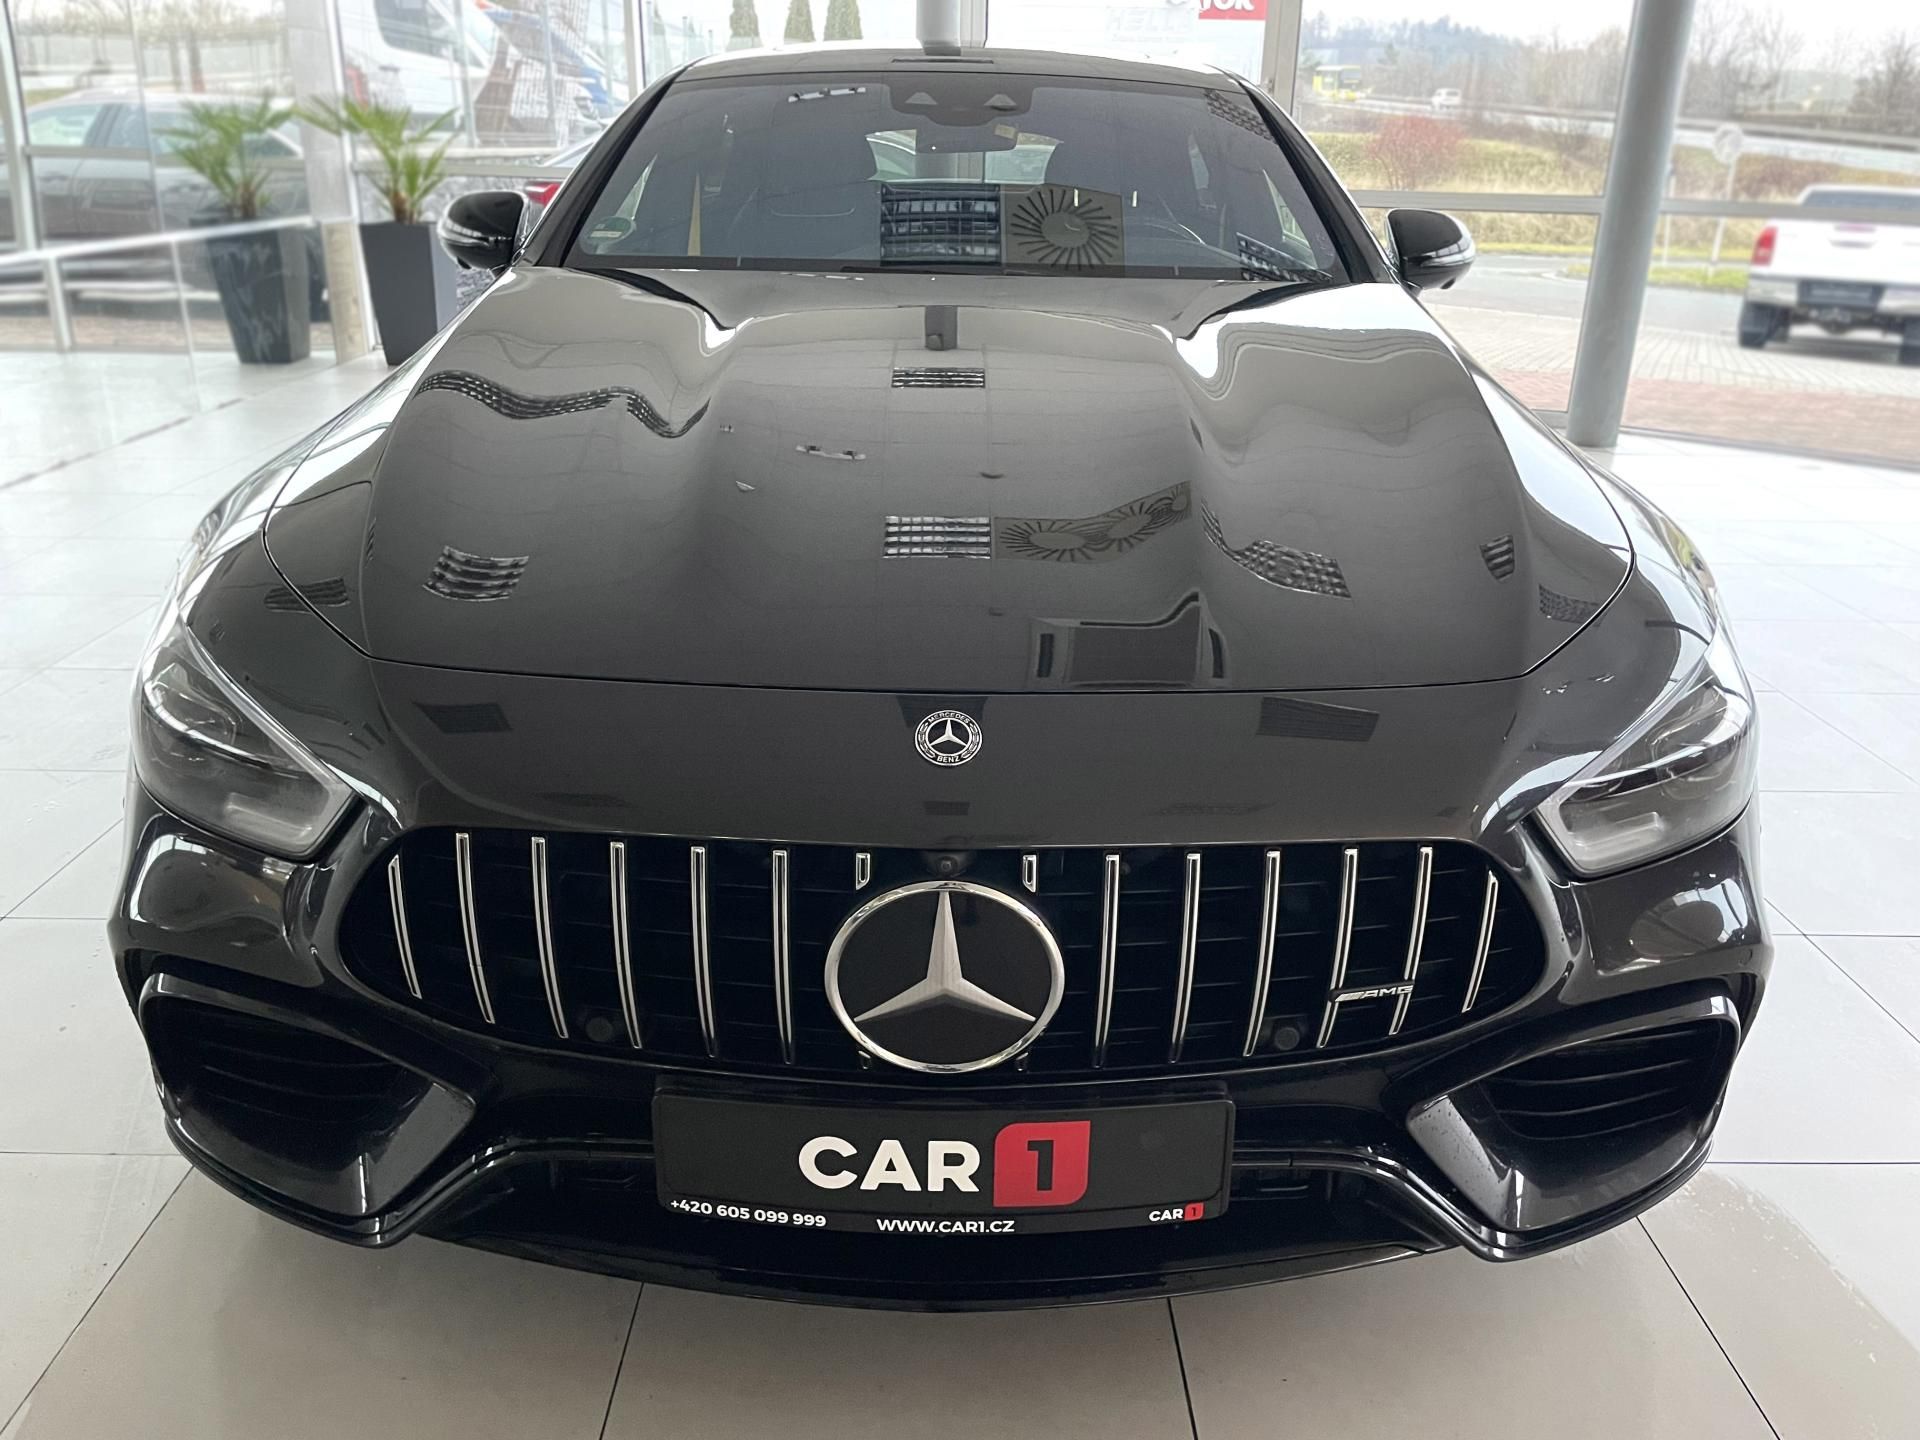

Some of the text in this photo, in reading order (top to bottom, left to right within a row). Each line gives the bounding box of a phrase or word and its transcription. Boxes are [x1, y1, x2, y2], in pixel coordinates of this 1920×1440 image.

[928, 711, 970, 724] MERCEDES
[936, 755, 961, 763] BENZ
[1360, 985, 1413, 999] AMG
[798, 1135, 1054, 1193] CAR 1
[670, 1199, 827, 1227] +420 605 099 999
[1148, 1208, 1183, 1221] CAR
[876, 1218, 1015, 1233] WWW.CAR1.CZ
